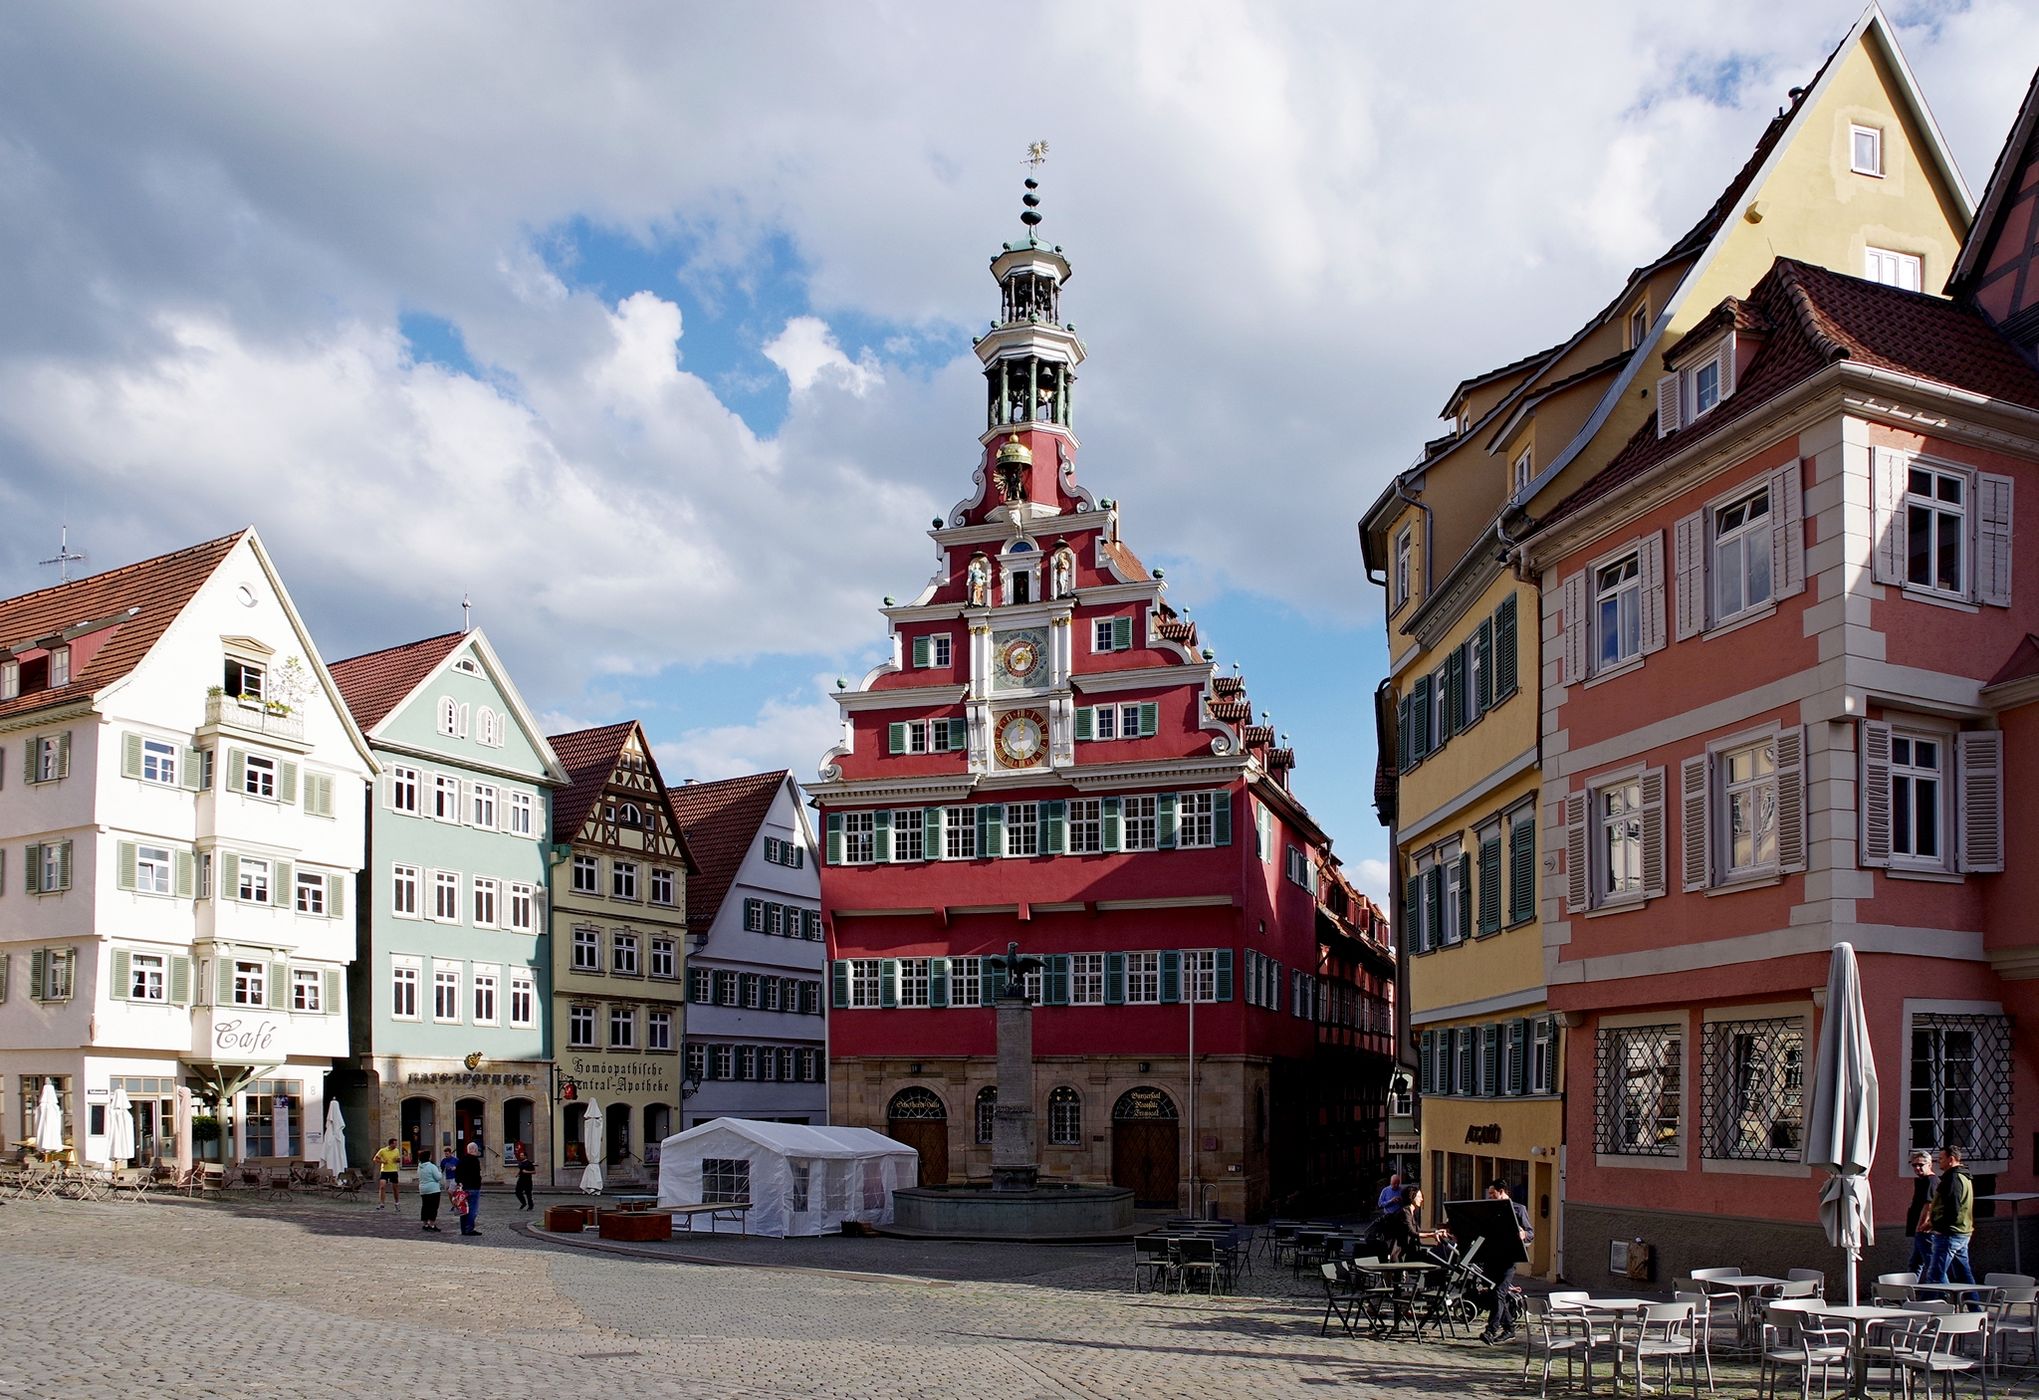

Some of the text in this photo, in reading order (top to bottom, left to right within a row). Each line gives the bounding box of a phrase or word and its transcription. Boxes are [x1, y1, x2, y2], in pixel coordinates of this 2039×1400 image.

[214, 1019, 277, 1054] Café
[407, 1073, 531, 1085] RATS-APOTHEKE
[577, 1076, 669, 1095] entral-Apotheke
[309, 1085, 316, 1096] 8
